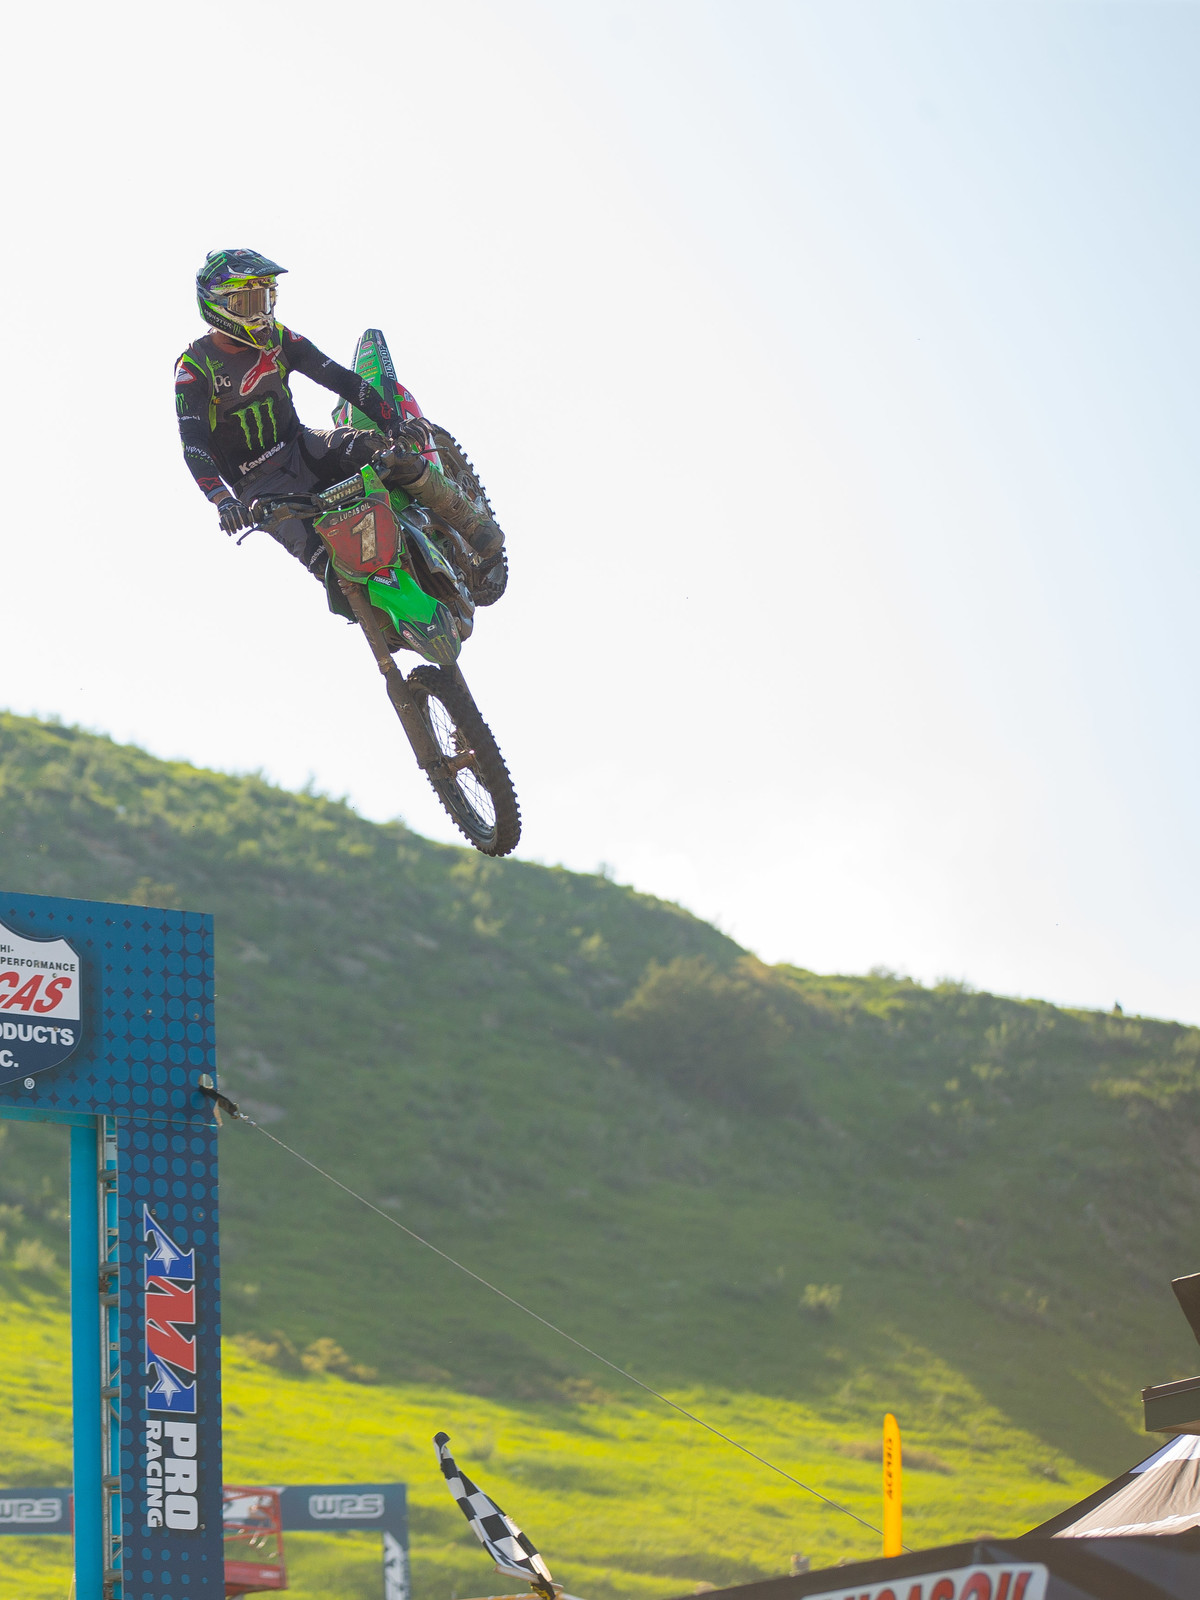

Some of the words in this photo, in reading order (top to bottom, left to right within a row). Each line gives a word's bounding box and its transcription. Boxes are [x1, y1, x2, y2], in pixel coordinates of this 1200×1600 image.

[339, 508, 360, 522] LUCAS
[360, 502, 371, 511] OIL
[351, 511, 377, 563] 1
[0, 956, 76, 972] PERFORMANCE
[143, 1202, 198, 1414] AMA
[145, 1420, 163, 1528] RACING
[163, 1421, 199, 1531] PRO
[309, 1494, 385, 1519] WPS
